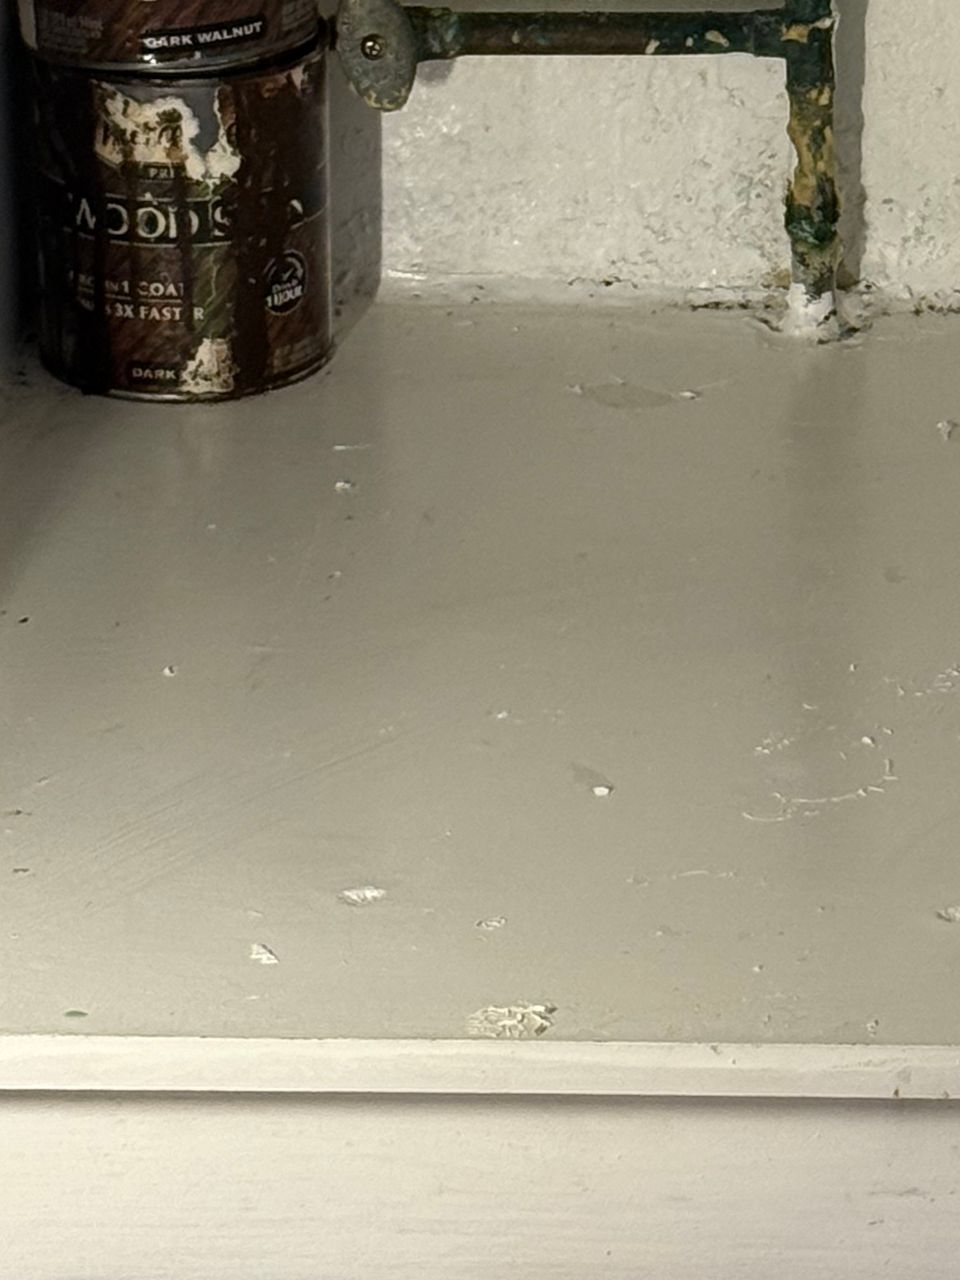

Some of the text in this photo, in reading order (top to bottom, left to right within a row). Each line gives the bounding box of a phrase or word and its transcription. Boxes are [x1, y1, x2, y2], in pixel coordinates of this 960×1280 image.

[196, 21, 264, 44] WALNUT
[114, 302, 136, 320] 3X
[138, 305, 205, 322] FASTR
[131, 367, 177, 380] DARK
